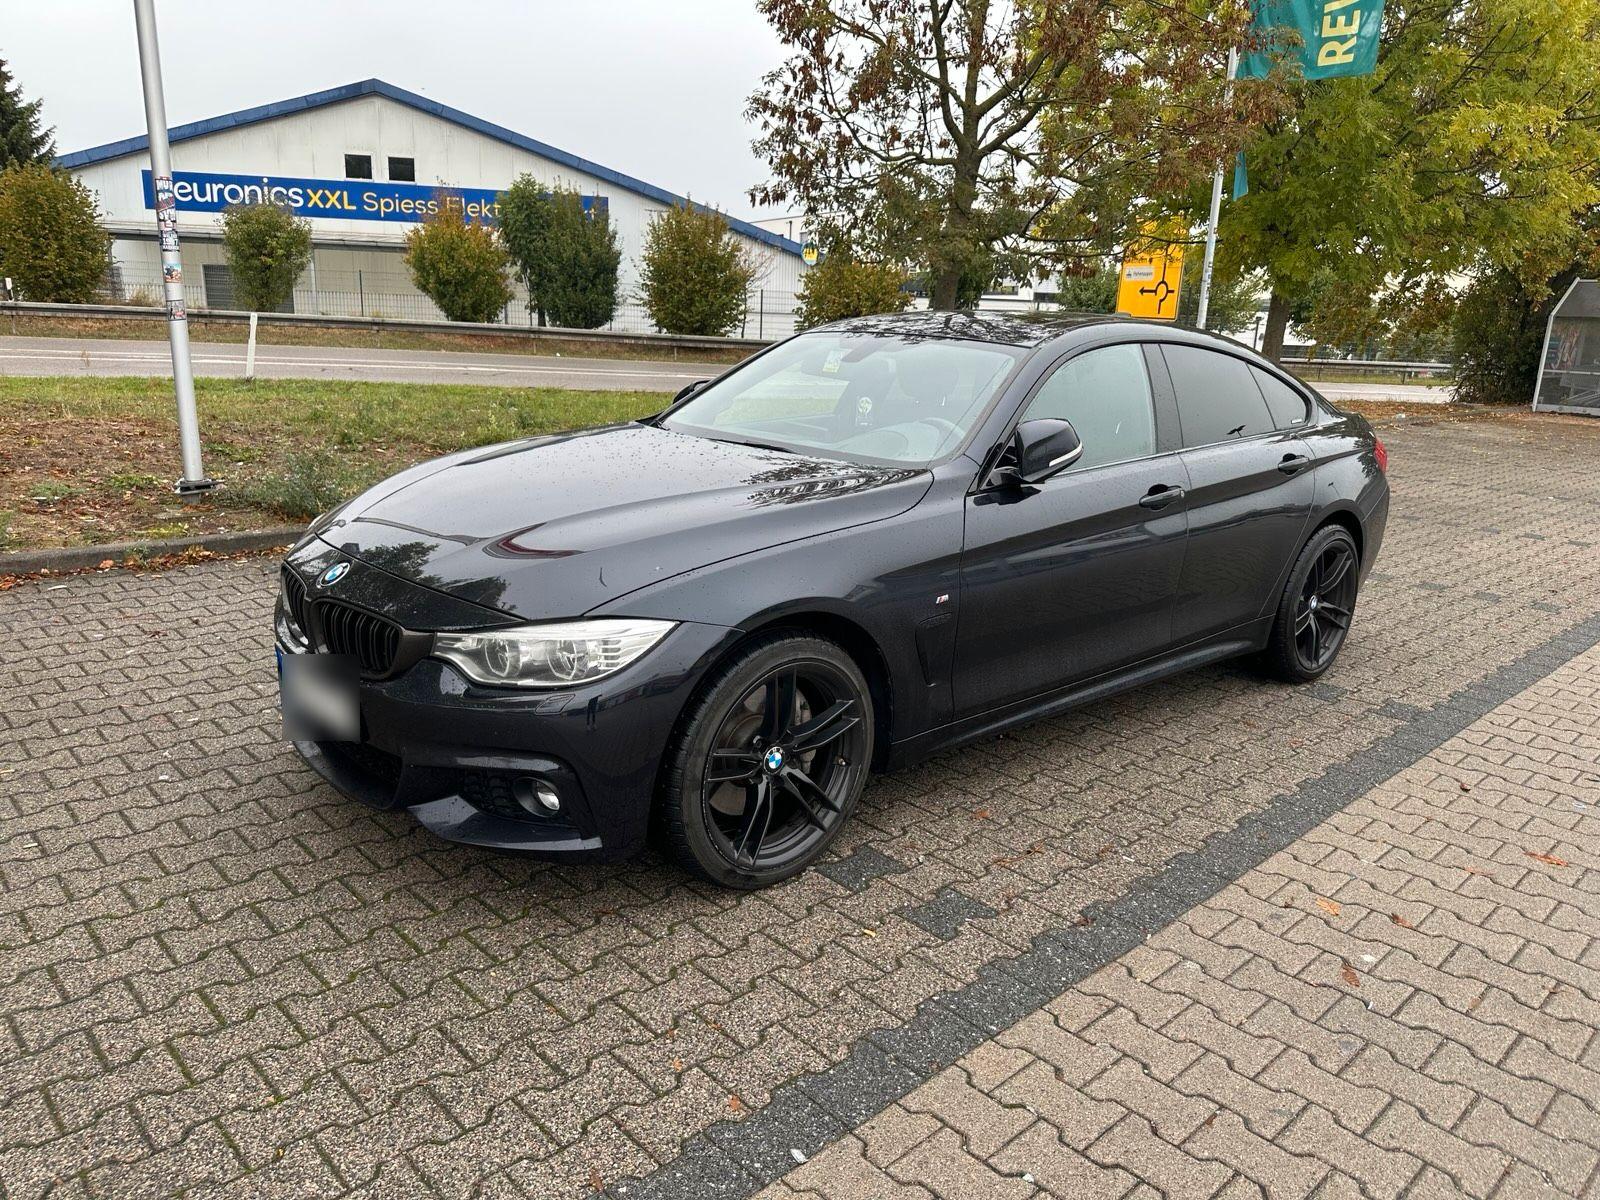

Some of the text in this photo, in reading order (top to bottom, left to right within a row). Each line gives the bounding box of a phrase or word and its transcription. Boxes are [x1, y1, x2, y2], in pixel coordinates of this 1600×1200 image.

[173, 177, 304, 208] euronics
[306, 188, 357, 210] XXL
[363, 191, 439, 218] Spiess
